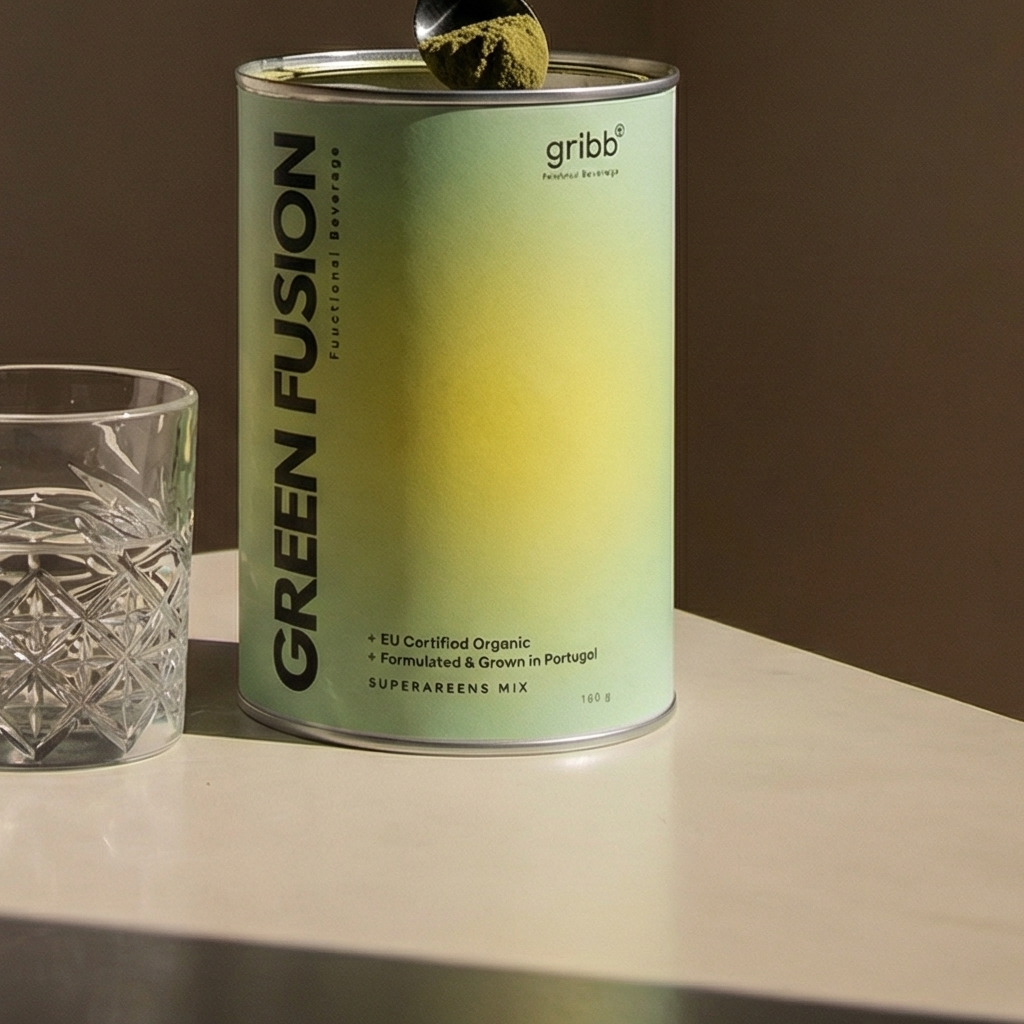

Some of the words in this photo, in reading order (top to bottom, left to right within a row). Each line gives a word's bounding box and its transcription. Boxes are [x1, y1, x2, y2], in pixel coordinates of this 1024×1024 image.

[546, 130, 619, 169] gribb
[273, 131, 318, 416] FUSION
[273, 429, 318, 693] GREEN
[380, 633, 400, 647] EU
[473, 636, 531, 653] Organic
[380, 652, 461, 669] Formulated
[465, 656, 475, 669] &
[478, 656, 525, 669] Grown
[529, 654, 541, 667] in
[498, 681, 528, 694] MIX
